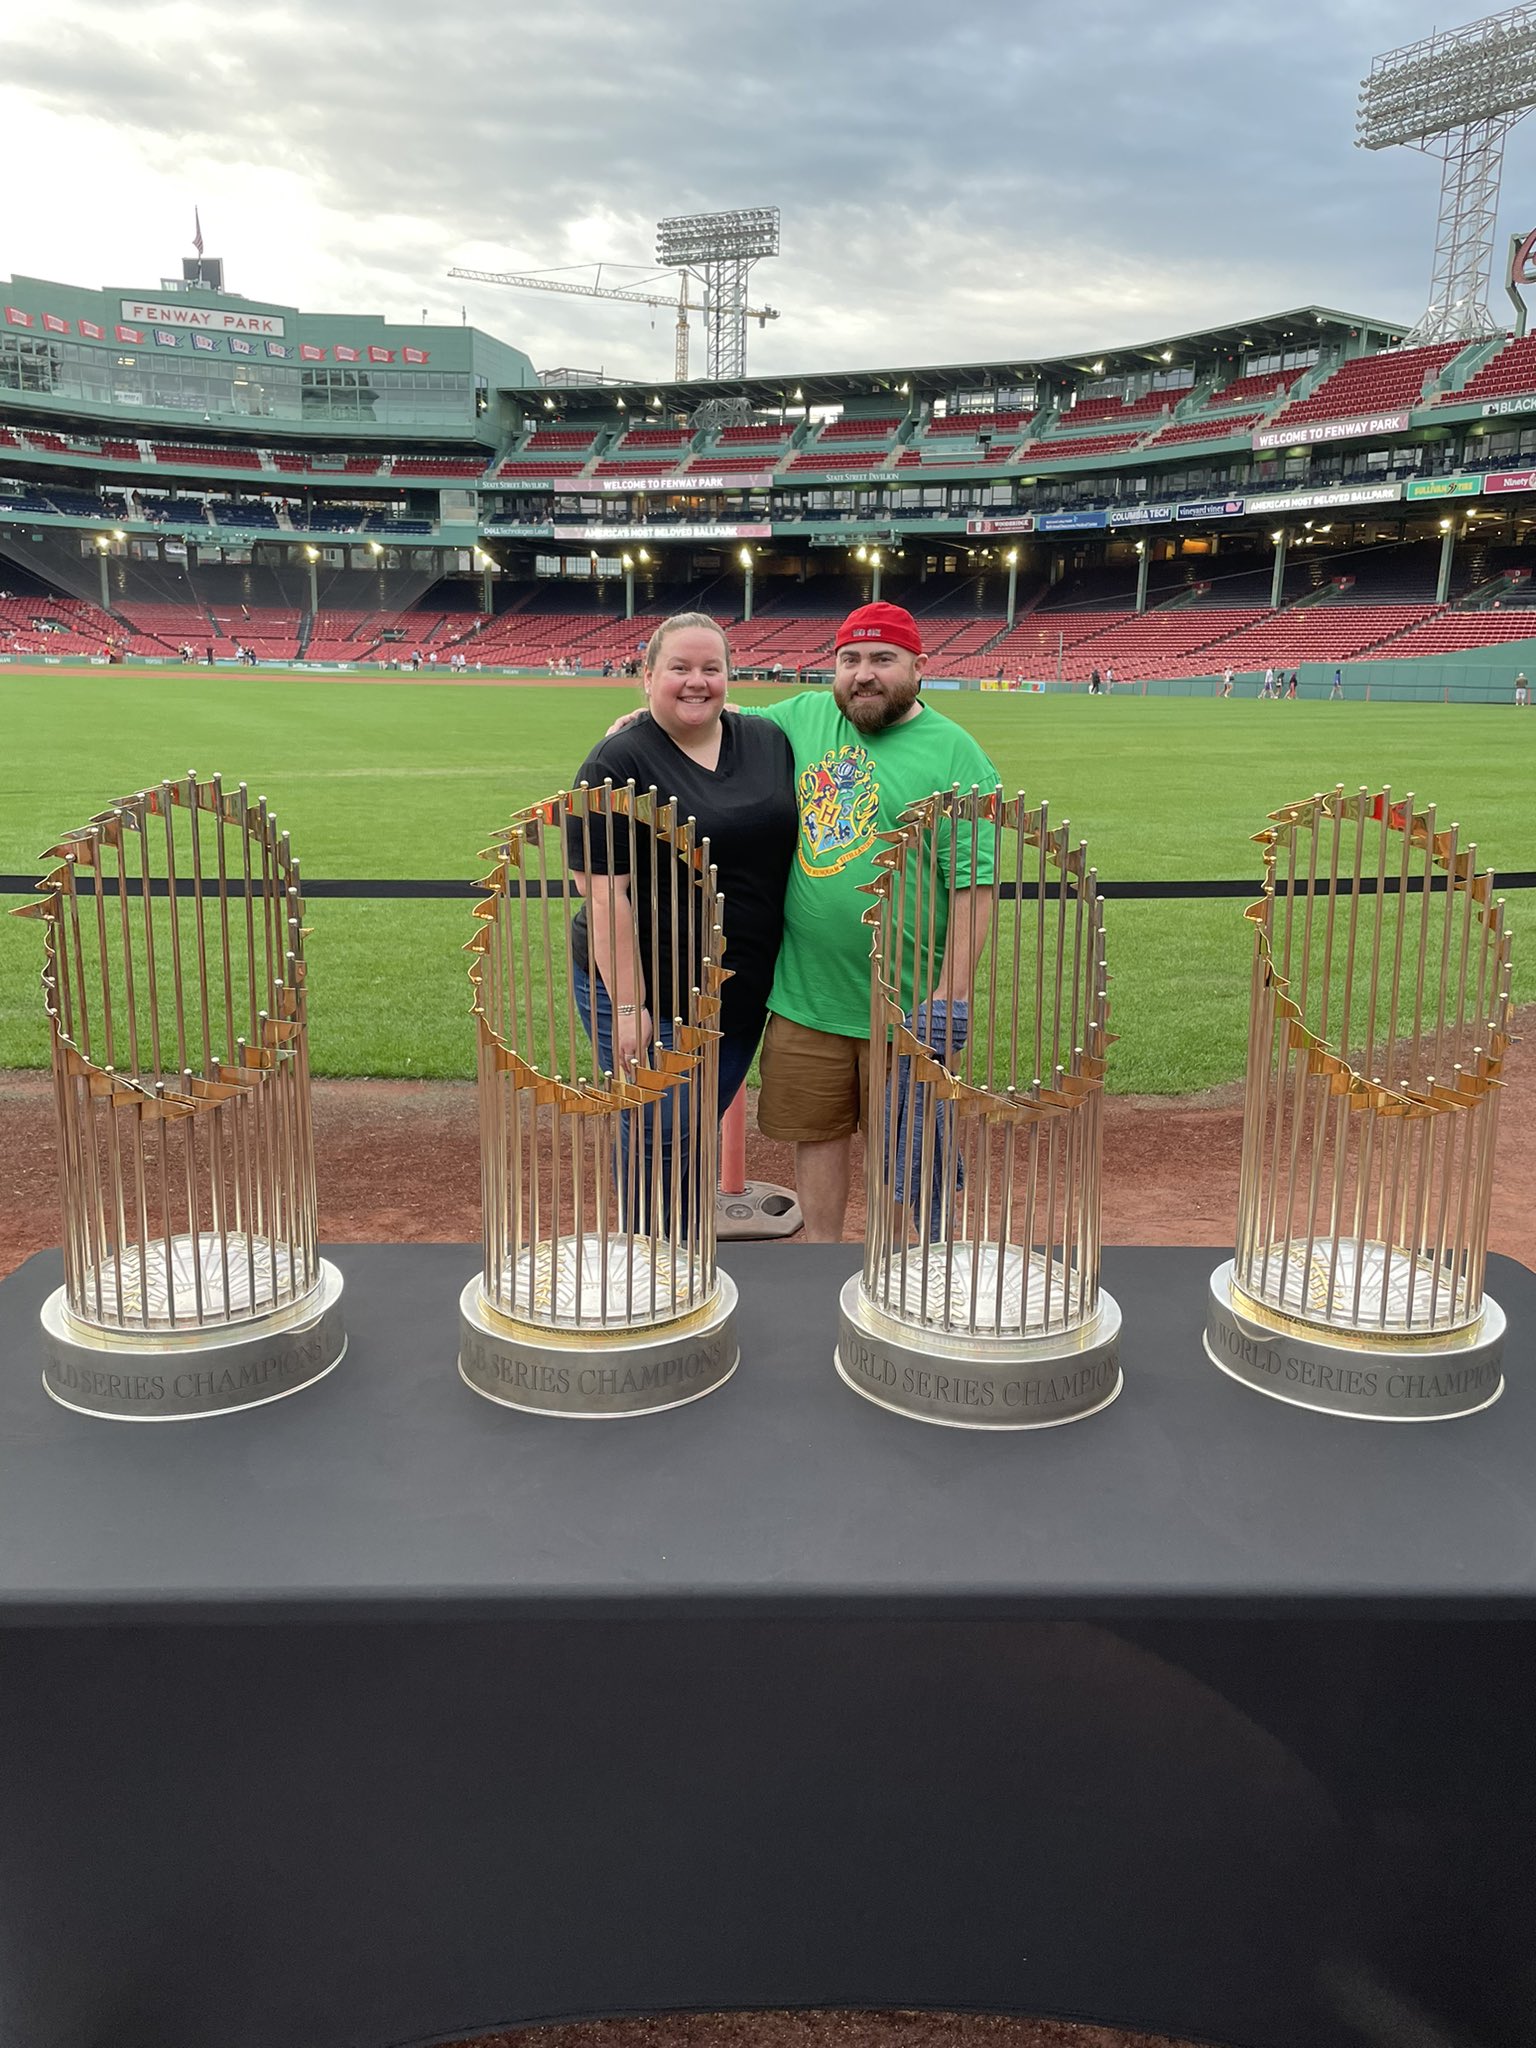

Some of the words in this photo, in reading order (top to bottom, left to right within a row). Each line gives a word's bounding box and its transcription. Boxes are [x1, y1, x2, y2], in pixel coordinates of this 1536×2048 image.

[133, 306, 211, 325] FENWAY
[223, 315, 273, 332] PARK
[1259, 429, 1307, 446] WELCOME
[1309, 427, 1324, 440] TO
[1324, 422, 1369, 438] FENWAY
[1369, 417, 1400, 432] PARK
[603, 480, 648, 490] WELCOME
[648, 480, 660, 489] TO
[660, 479, 698, 489] FENWAY
[698, 478, 723, 488] PARK
[1503, 478, 1529, 488] Ninety
[1179, 504, 1207, 516] vineyard
[1207, 504, 1225, 513] vines
[1250, 498, 1291, 511] AMERICA'S
[1291, 496, 1313, 507] MOST
[1313, 492, 1350, 506] BELOVED
[1350, 488, 1395, 502] BALLPARK
[1111, 509, 1149, 521] COLUMBIA
[1149, 508, 1169, 518] TECH
[534, 526, 549, 535] Level
[630, 528, 654, 537] MOST
[654, 527, 693, 537] BELOVED
[693, 526, 738, 536] BALLPARK
[820, 803, 838, 826] H
[80, 1369, 165, 1401] SERIES
[173, 1341, 323, 1399] CHAMPIONS
[492, 1353, 570, 1395] SERIES
[577, 1341, 722, 1395] CHAMPIONS
[1216, 1322, 1282, 1375] WORLD
[1285, 1357, 1378, 1397] SERIES
[902, 1367, 995, 1407] SERIES
